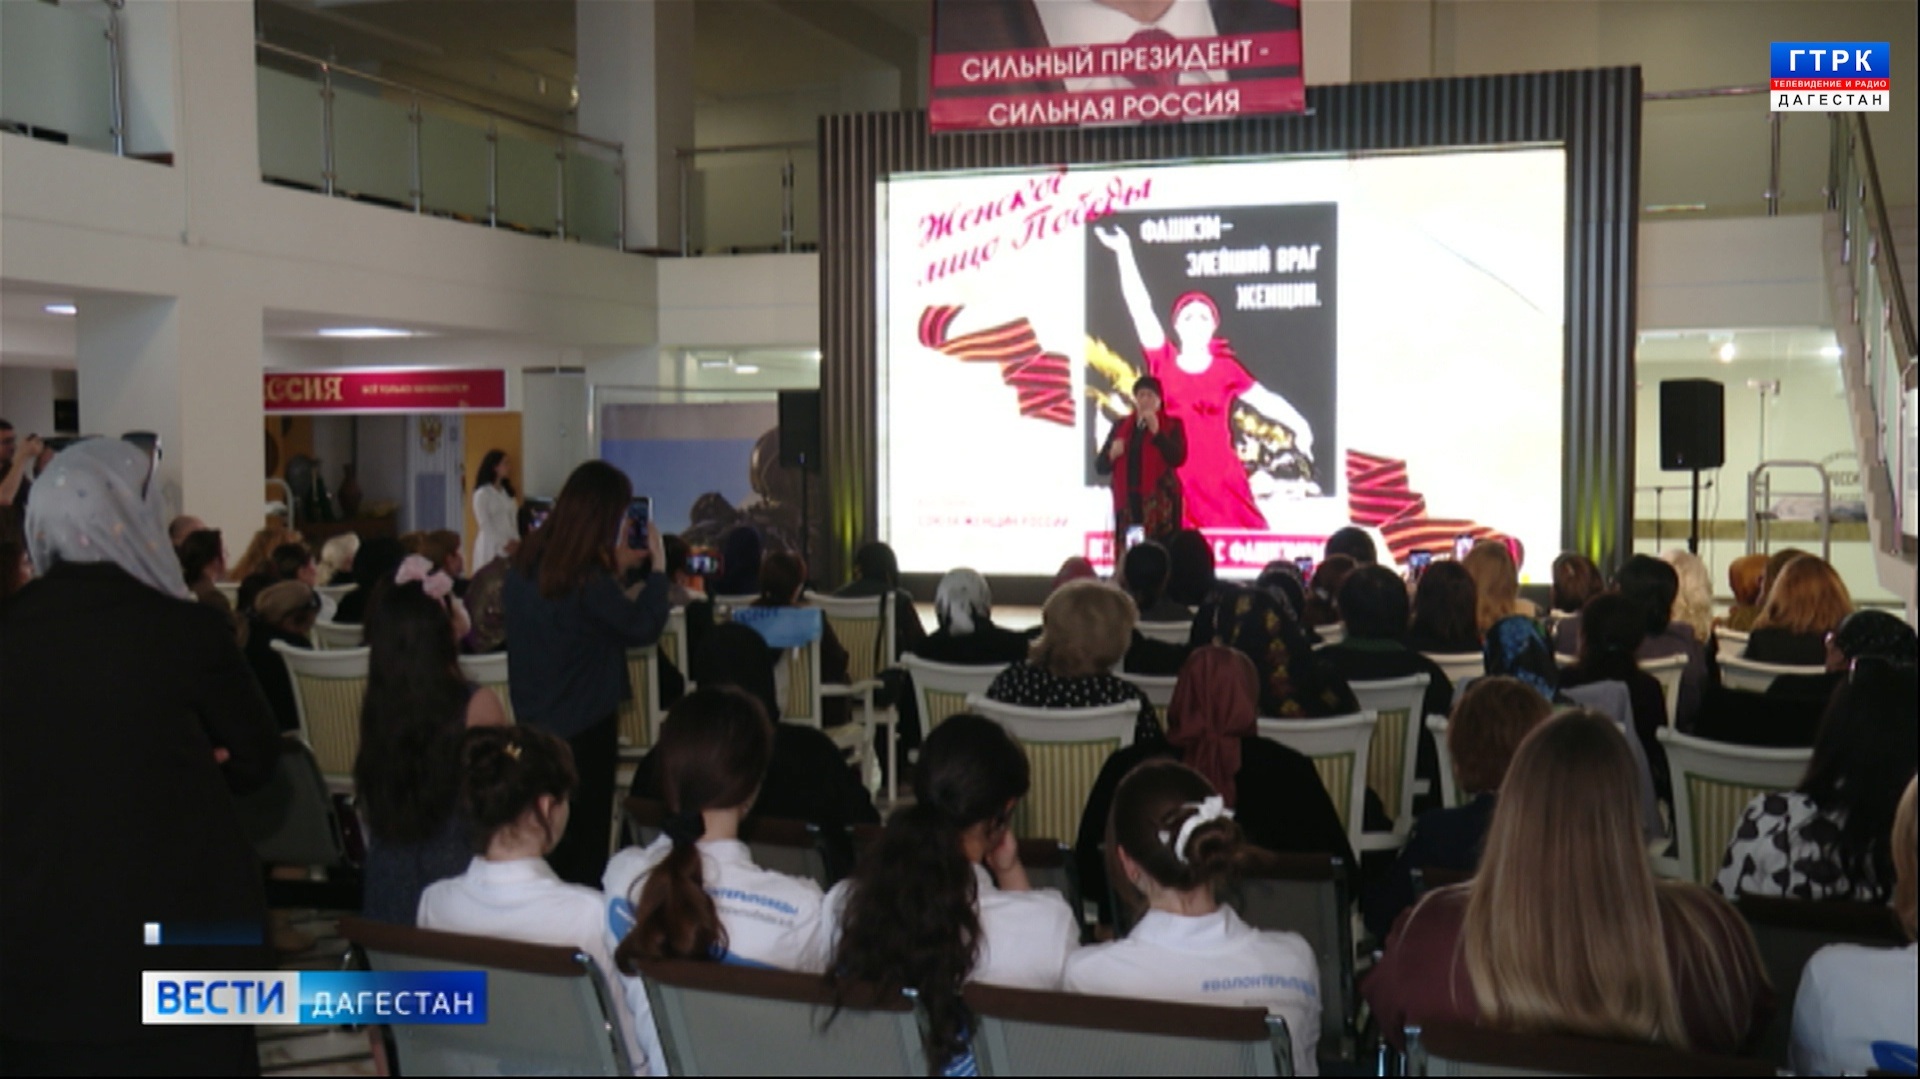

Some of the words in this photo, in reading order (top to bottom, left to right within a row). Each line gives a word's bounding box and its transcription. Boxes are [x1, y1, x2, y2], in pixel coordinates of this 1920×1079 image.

[961, 46, 1093, 81] СИЛЬНЫЙ
[1101, 39, 1253, 73] ПРЕЗИДЕНТ
[988, 97, 1114, 127] СИЛЬНАЯ
[1123, 89, 1241, 119] РОССИЯ
[1011, 175, 1153, 250] Победы
[1185, 244, 1272, 278] ЗЛЕЙШИЙ
[1275, 243, 1322, 274] ВРАГ
[263, 376, 344, 402] ССИЯ
